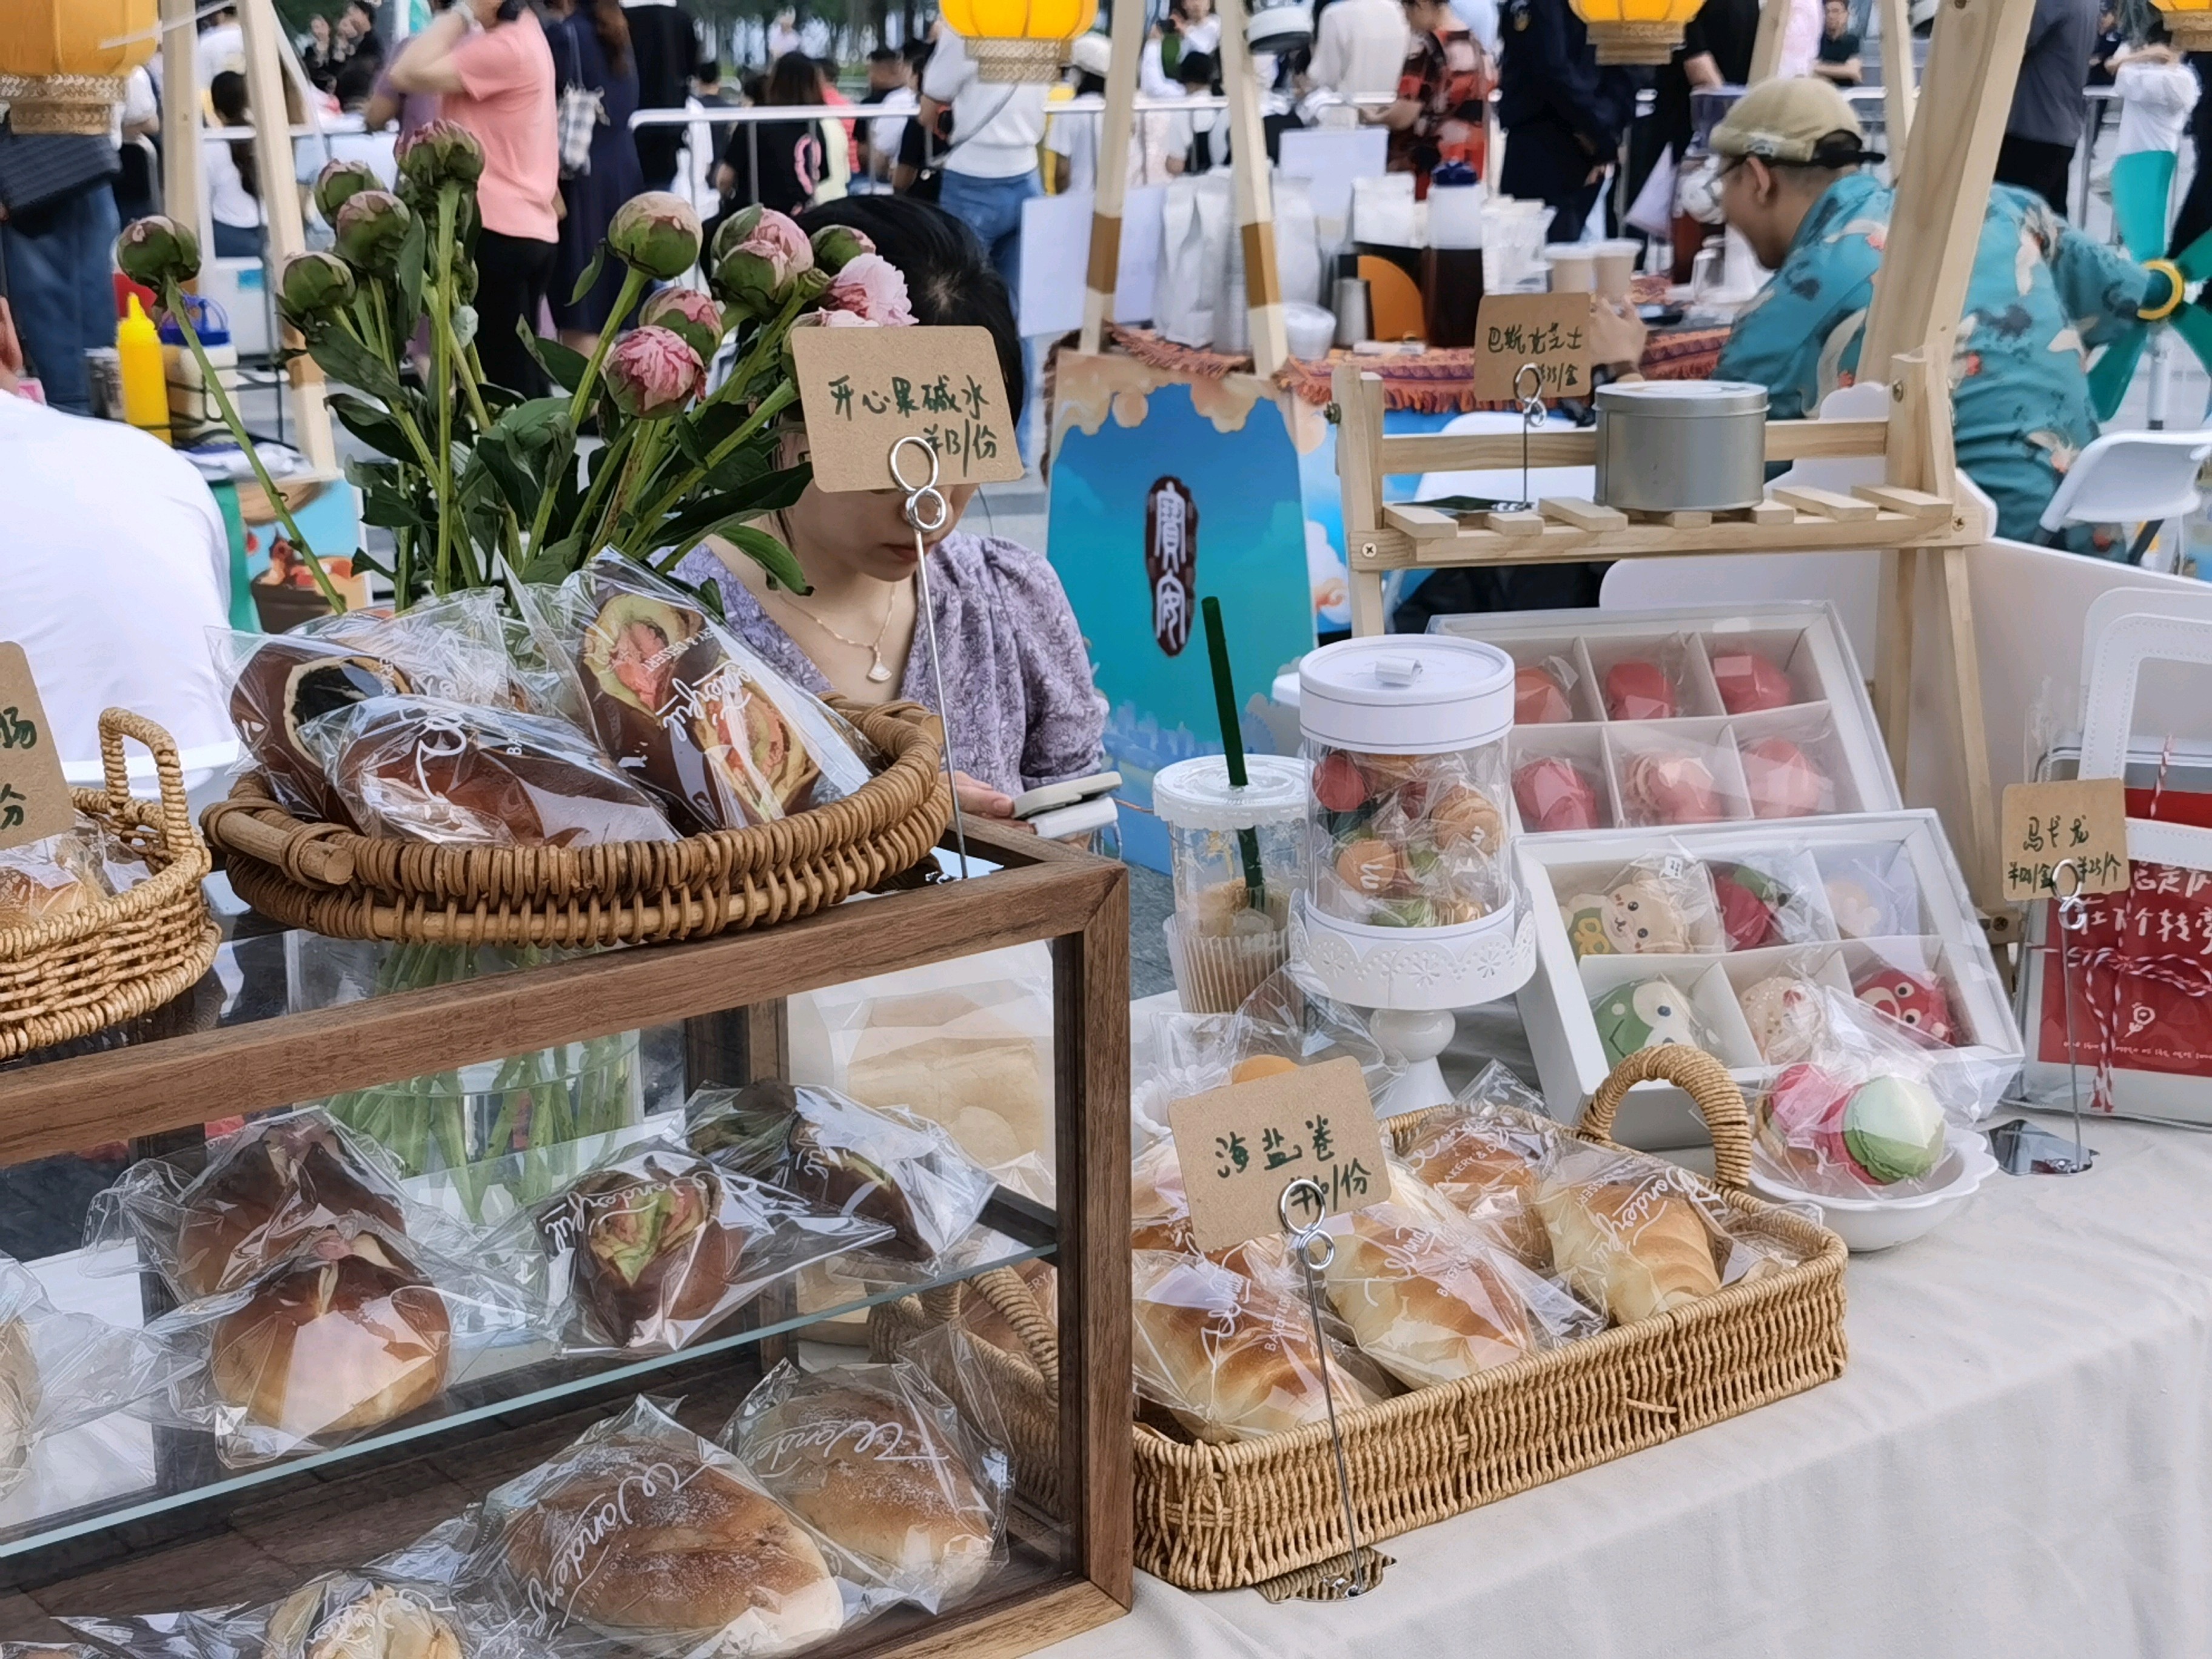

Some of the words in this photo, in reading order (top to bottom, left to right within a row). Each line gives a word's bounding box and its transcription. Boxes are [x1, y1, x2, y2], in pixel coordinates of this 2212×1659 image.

[828, 374, 990, 421] 开心果碱水
[640, 640, 689, 672] DESSERT
[2023, 814, 2090, 853] 马卡龙
[1215, 1114, 1335, 1178] 海盐卷
[1444, 1156, 1475, 1183] AKERY
